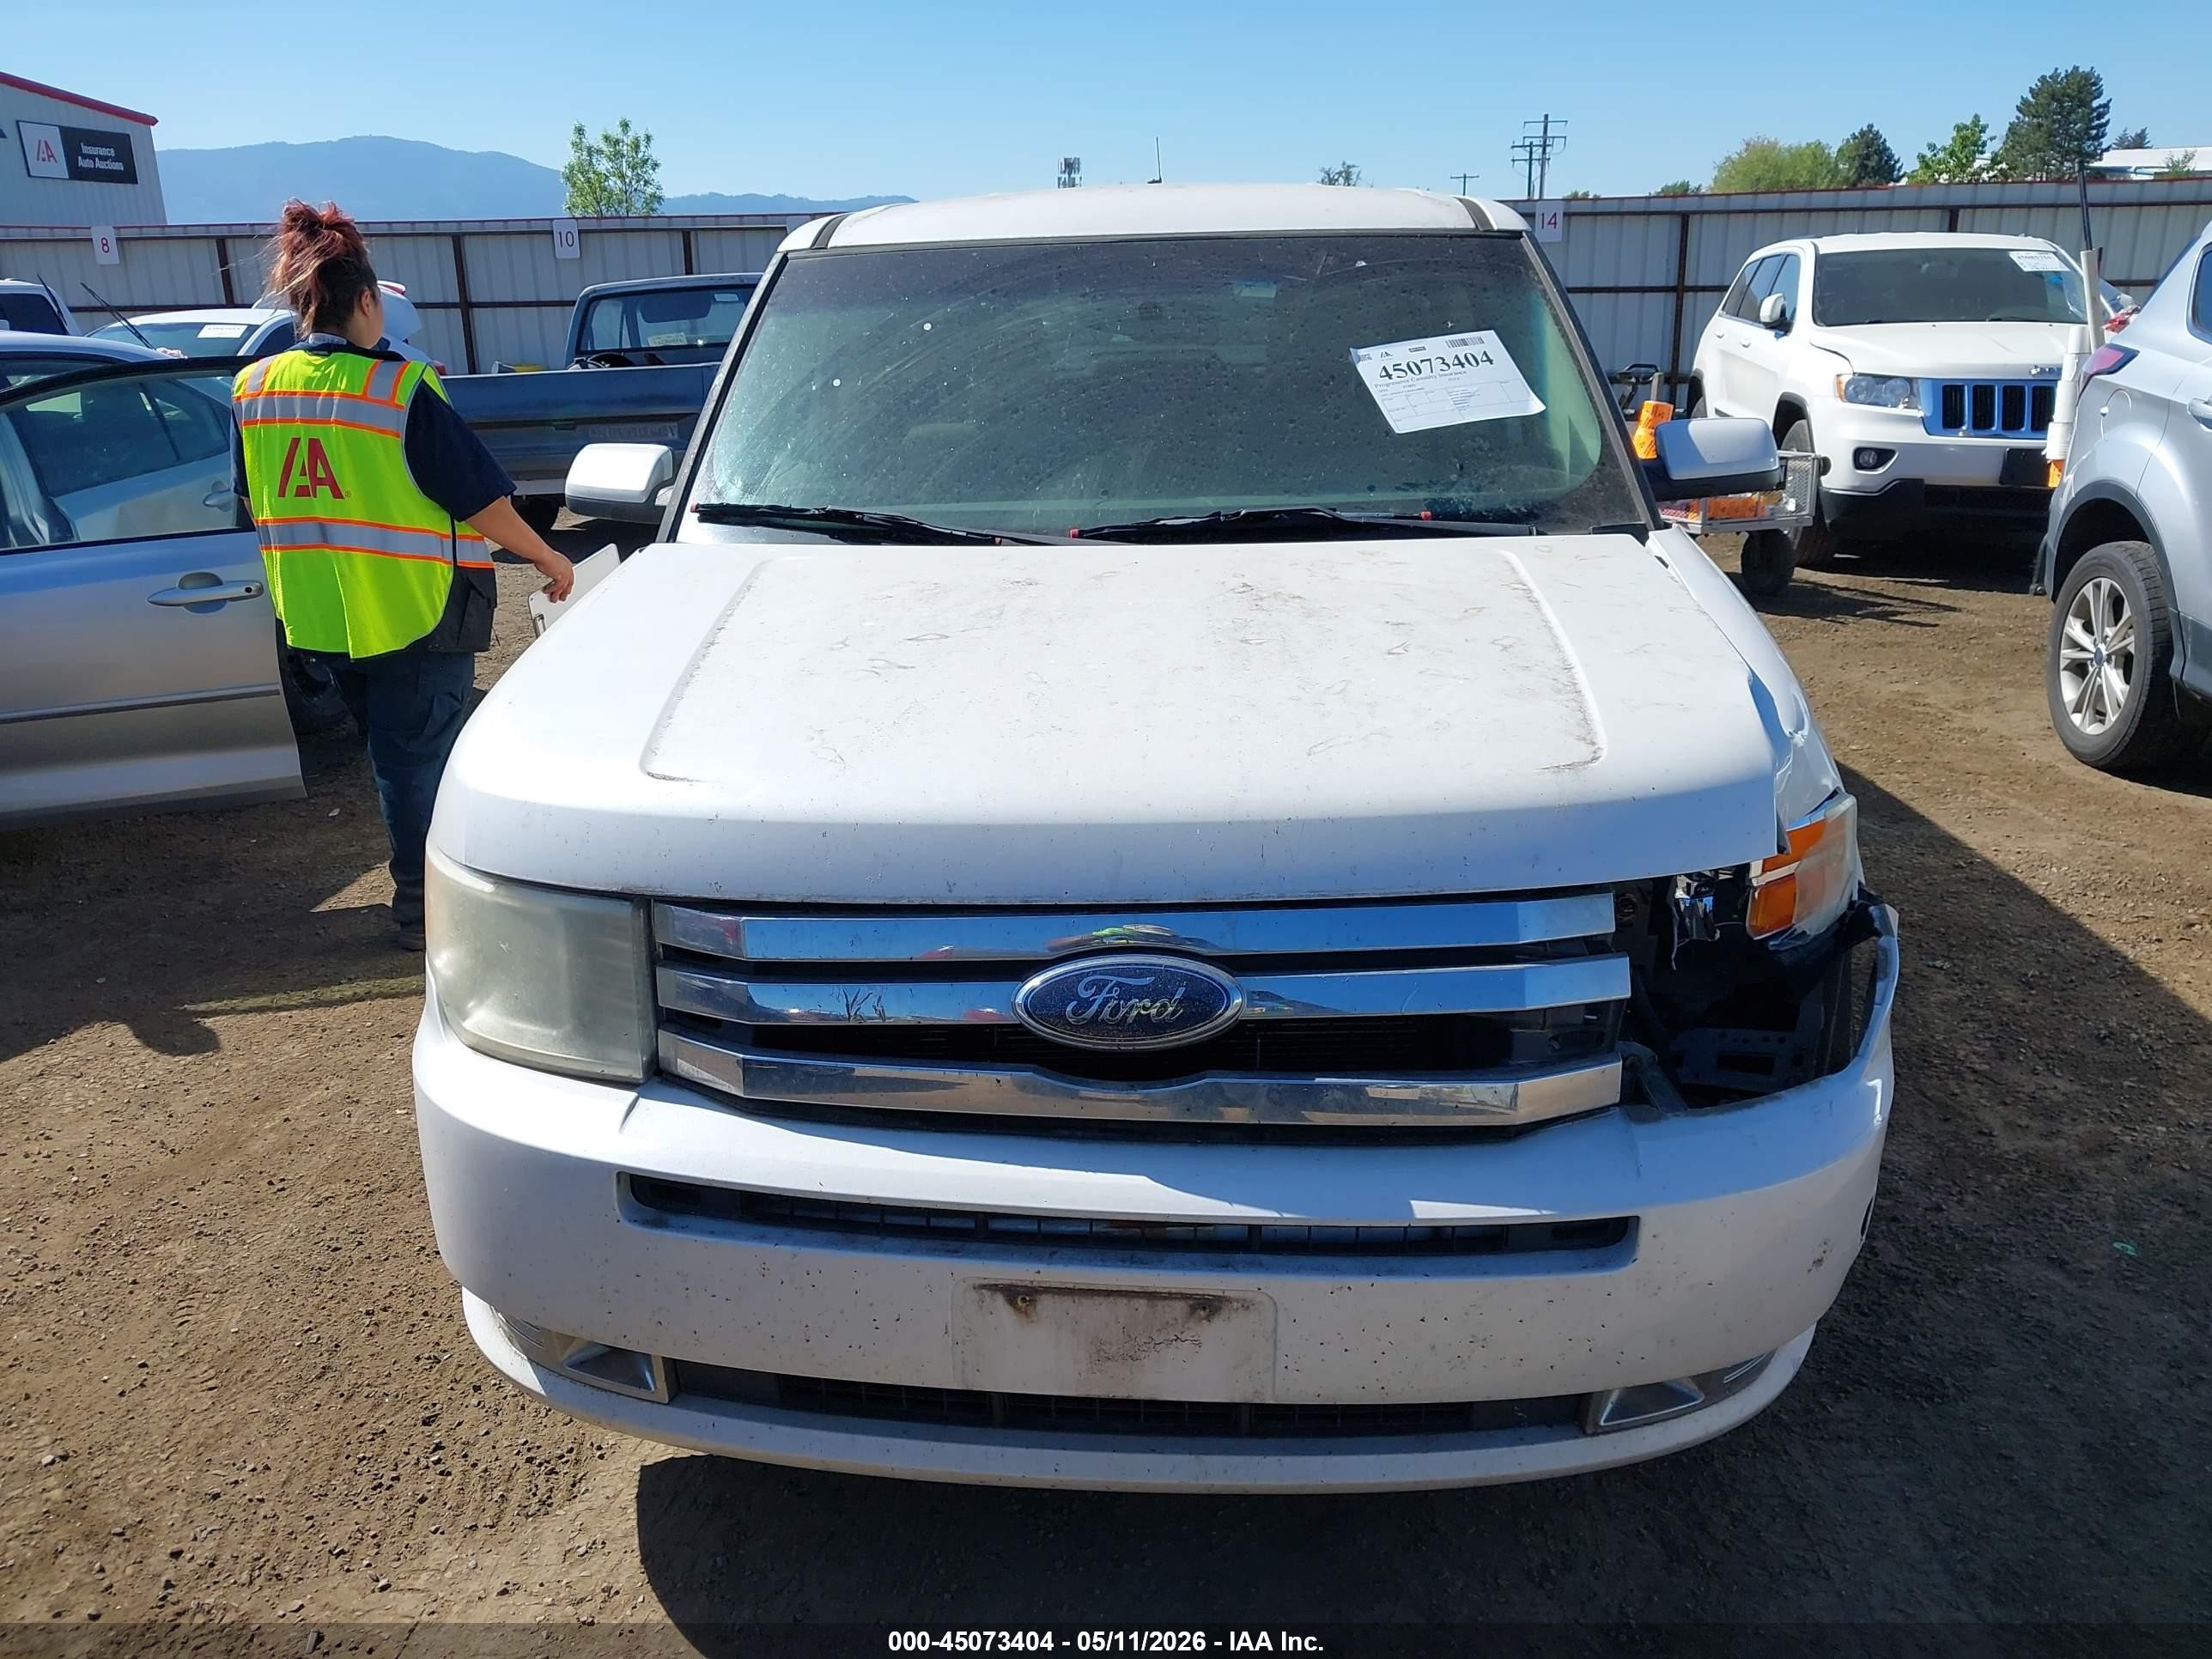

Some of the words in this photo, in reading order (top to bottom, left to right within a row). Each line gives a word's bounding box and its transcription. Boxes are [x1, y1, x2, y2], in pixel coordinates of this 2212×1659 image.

[81, 142, 115, 156] Insurance
[77, 155, 94, 168] Auto
[94, 158, 125, 171] Auctions
[1541, 212, 1558, 229] 14
[100, 237, 110, 253] 8
[558, 231, 574, 247] 10
[1379, 350, 1494, 380] 45073404
[1374, 378, 1409, 389] Progressive
[1411, 373, 1437, 383] Casualty
[1066, 975, 1187, 1025] Ford
